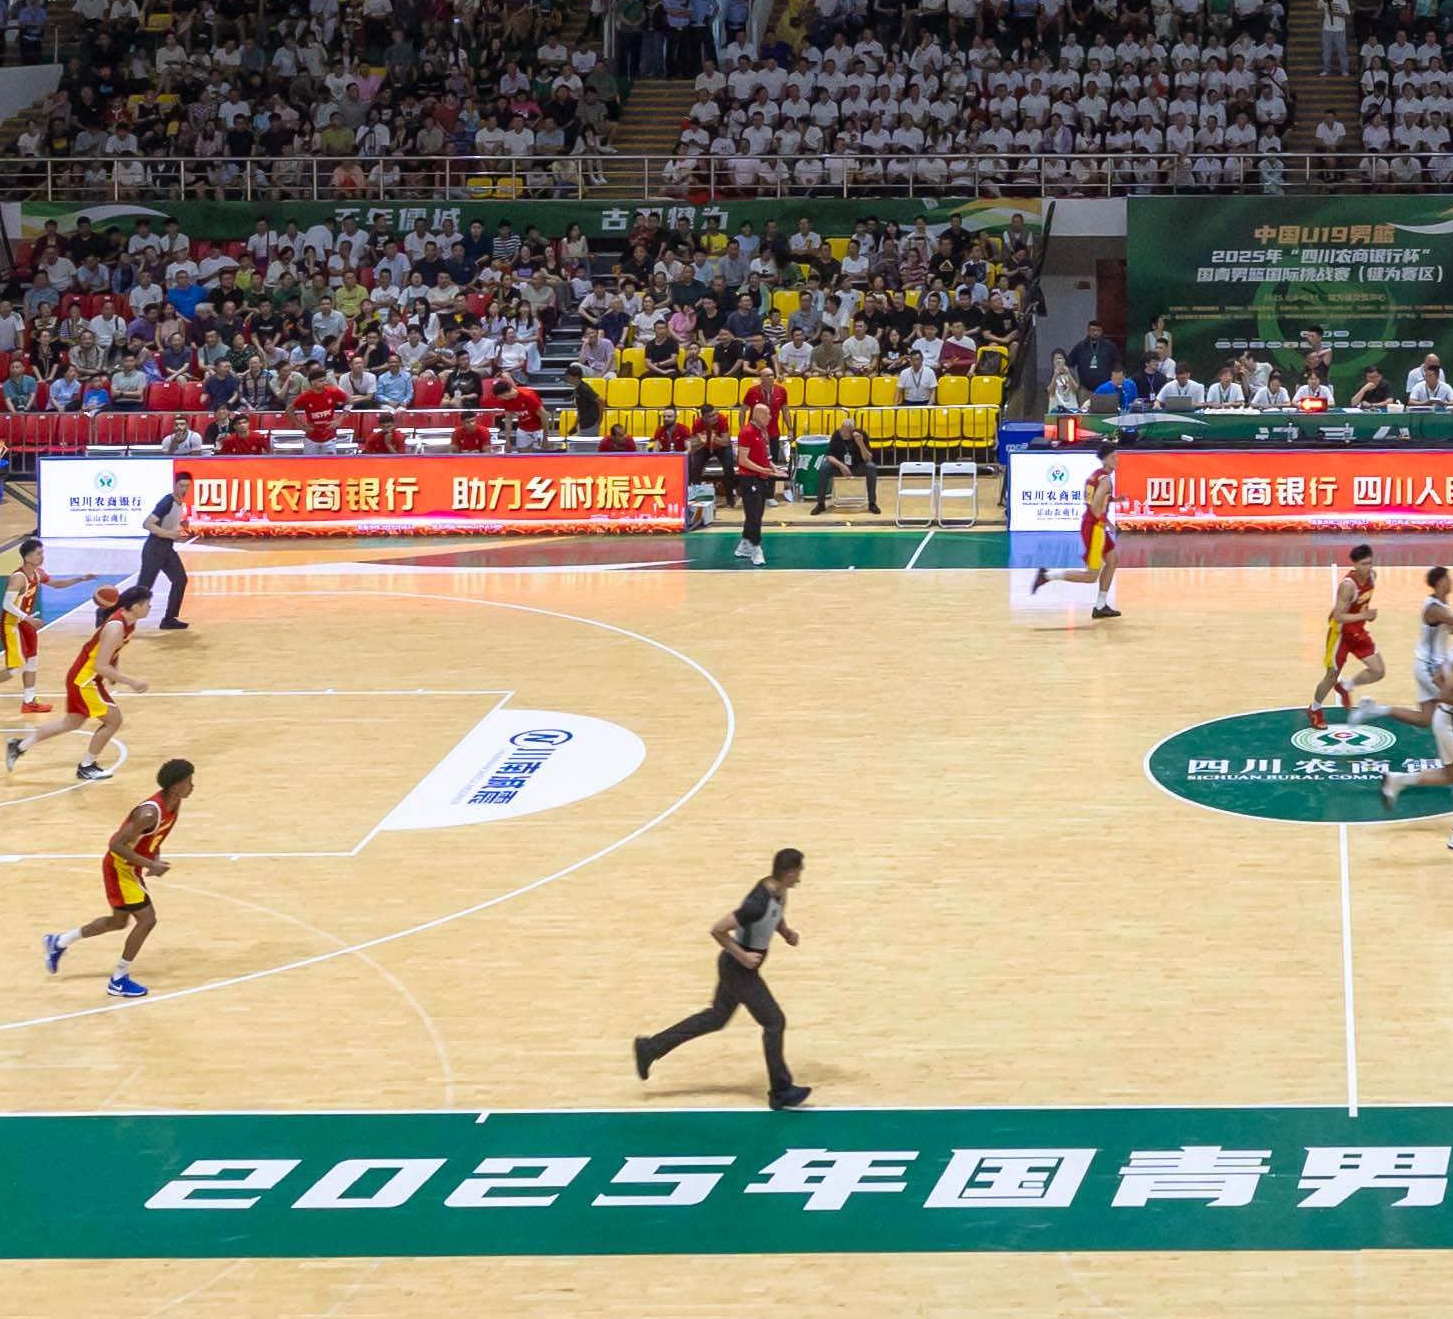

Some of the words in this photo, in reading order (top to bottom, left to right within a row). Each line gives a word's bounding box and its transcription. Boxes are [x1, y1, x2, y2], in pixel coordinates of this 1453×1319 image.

[1254, 224, 1396, 245] 中国U19男篮
[69, 495, 142, 508] 四川农商银行
[193, 476, 420, 513] 四川农商银行
[451, 475, 667, 512] 助力乡村振兴
[1021, 490, 1082, 502] 四川农商银
[1146, 476, 1338, 507] 四川农商银行
